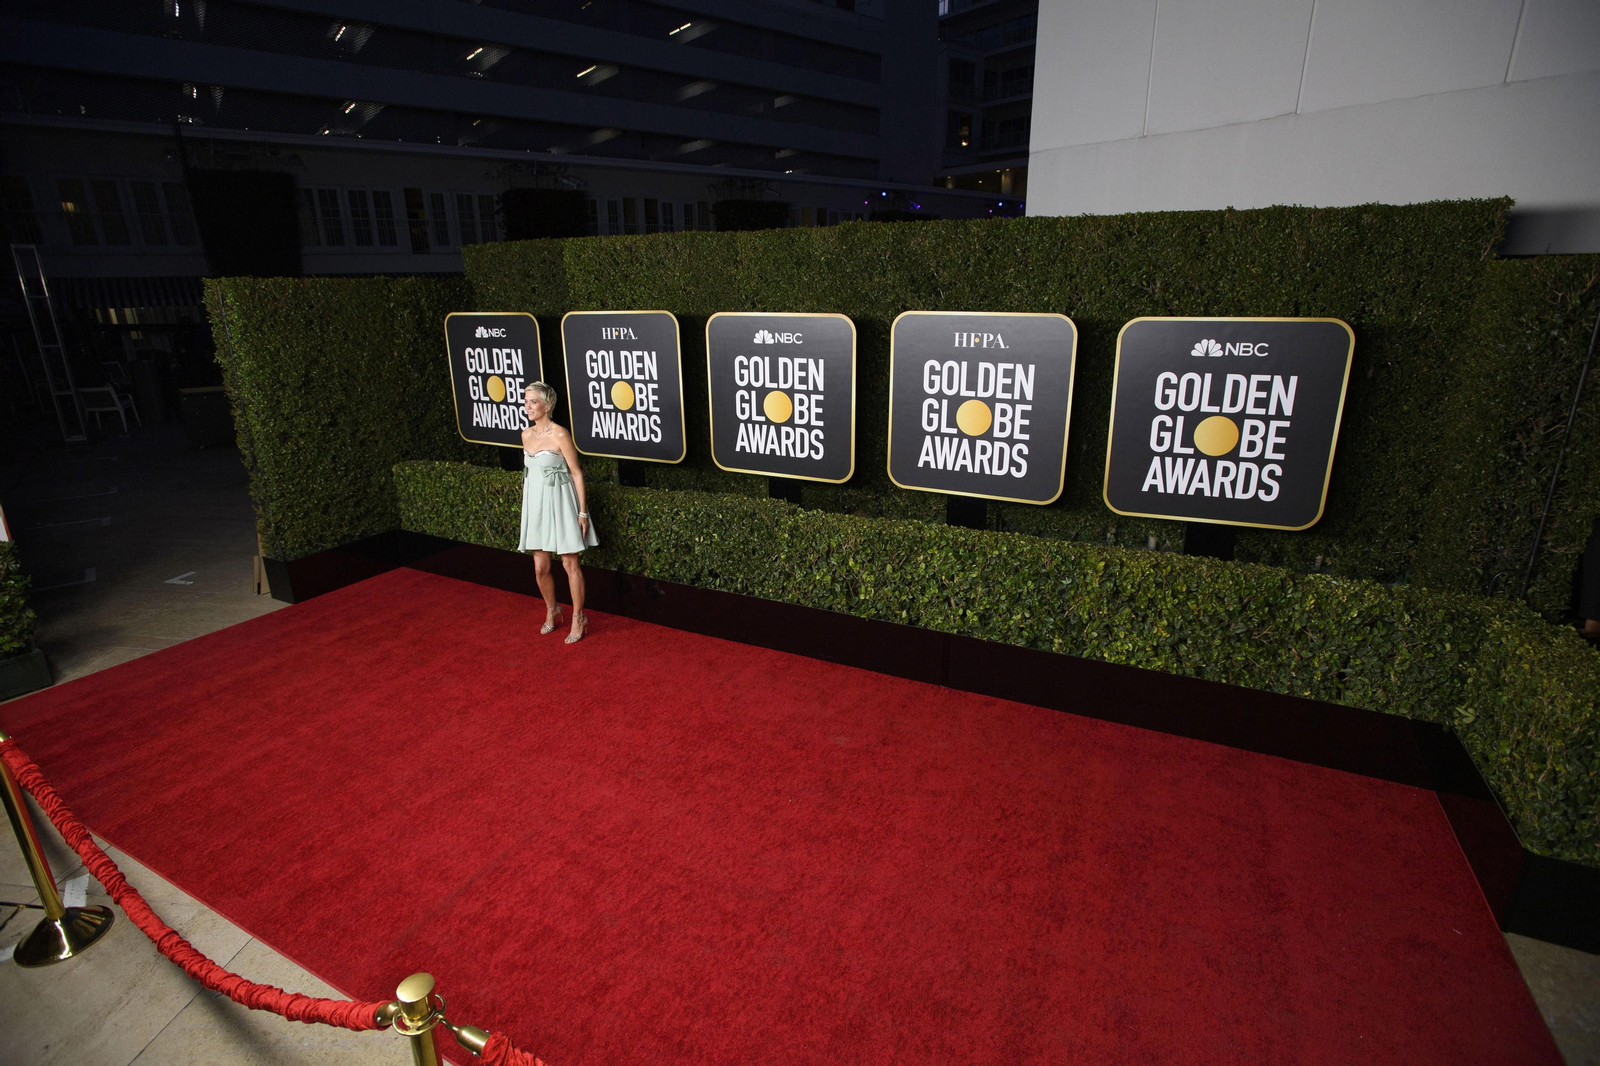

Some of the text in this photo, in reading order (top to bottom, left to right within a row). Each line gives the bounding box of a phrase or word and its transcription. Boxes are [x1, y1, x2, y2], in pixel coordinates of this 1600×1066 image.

[488, 328, 507, 338] NBC
[774, 332, 803, 344] NBC
[465, 347, 524, 375] GOLDEN
[585, 350, 658, 381] GOLDEN
[1224, 342, 1270, 357] NBC
[734, 355, 825, 392] GOLDEN
[923, 359, 1036, 401] GOLDEN
[1154, 371, 1299, 416] GOLDEN
[472, 402, 529, 430] AWARDS
[591, 411, 662, 443] AWARDS
[735, 422, 825, 460] AWARDS
[917, 435, 1029, 479] AWARDS
[1141, 455, 1283, 502] AWARDS
